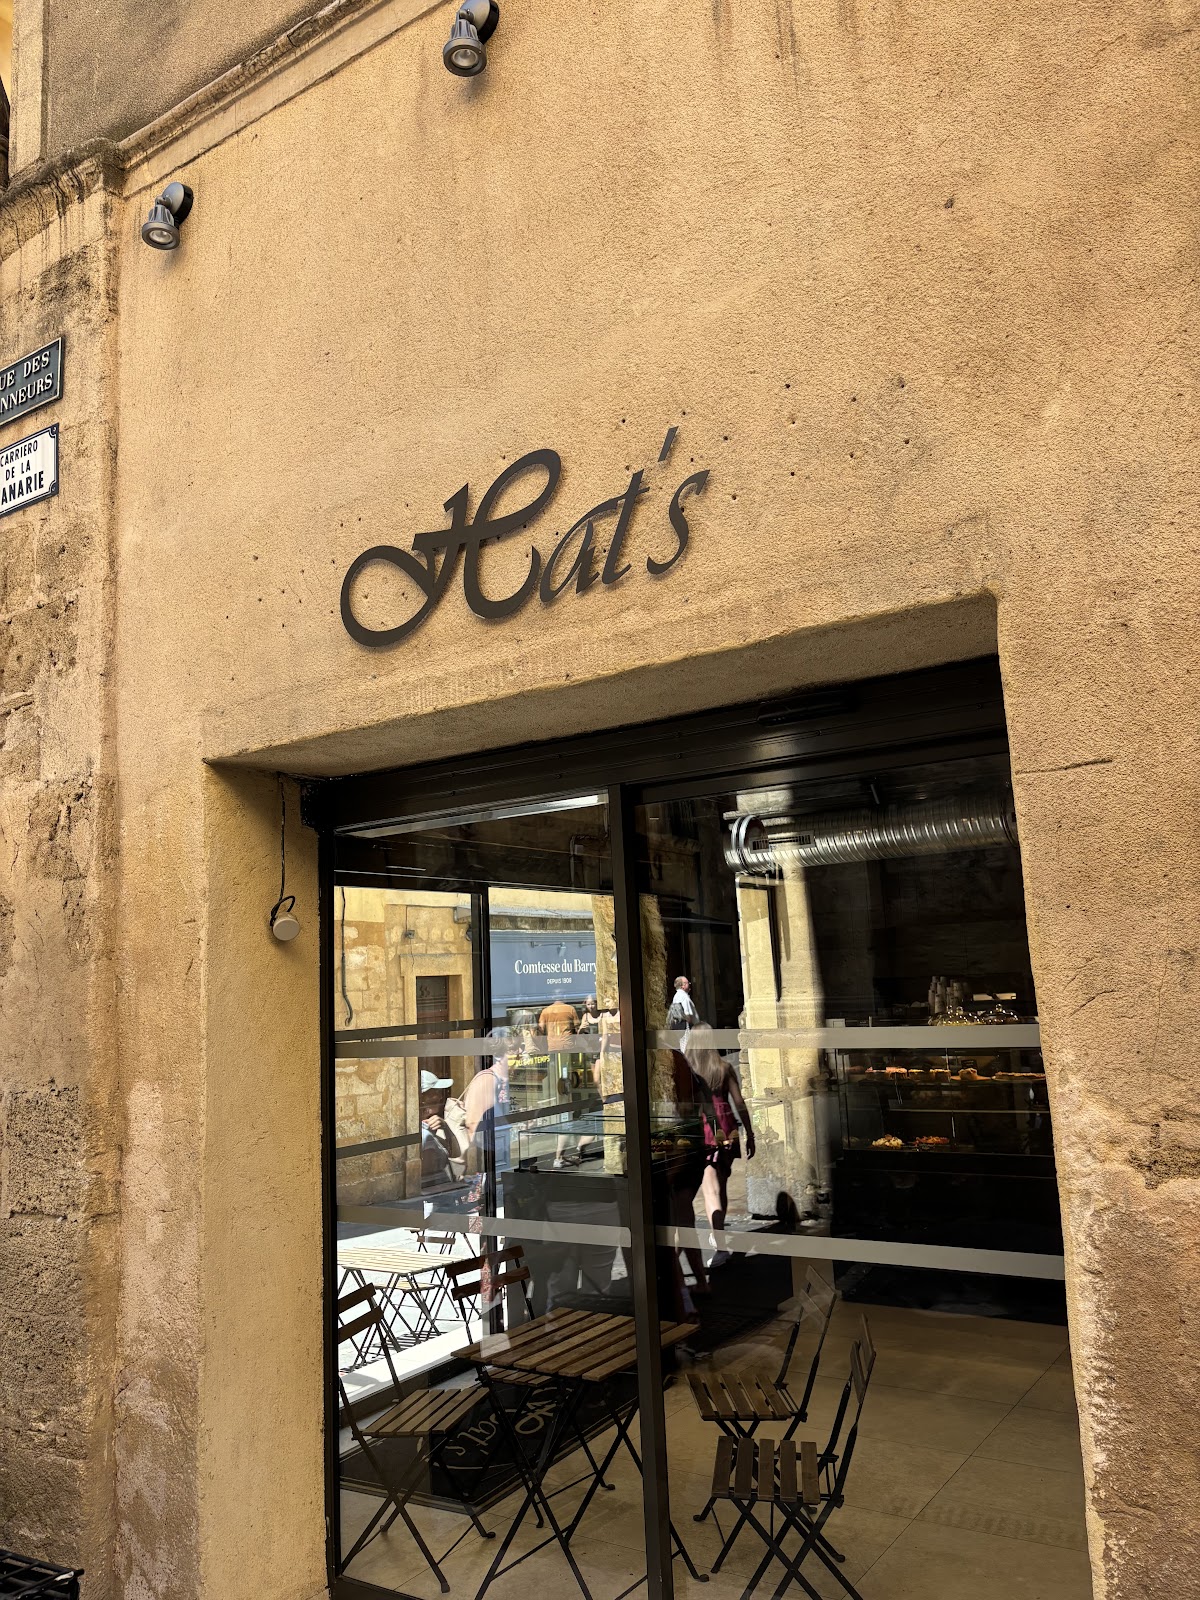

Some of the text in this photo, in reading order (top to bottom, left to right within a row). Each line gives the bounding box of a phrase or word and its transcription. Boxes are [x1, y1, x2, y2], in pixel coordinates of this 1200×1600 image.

[23, 351, 50, 378] DES
[0, 439, 38, 467] CARRIERO
[5, 459, 31, 481] DE LA
[1, 470, 44, 505] ANARIE
[340, 426, 710, 647] Hat's
[514, 959, 560, 975] Comtesse
[561, 958, 573, 973] du
